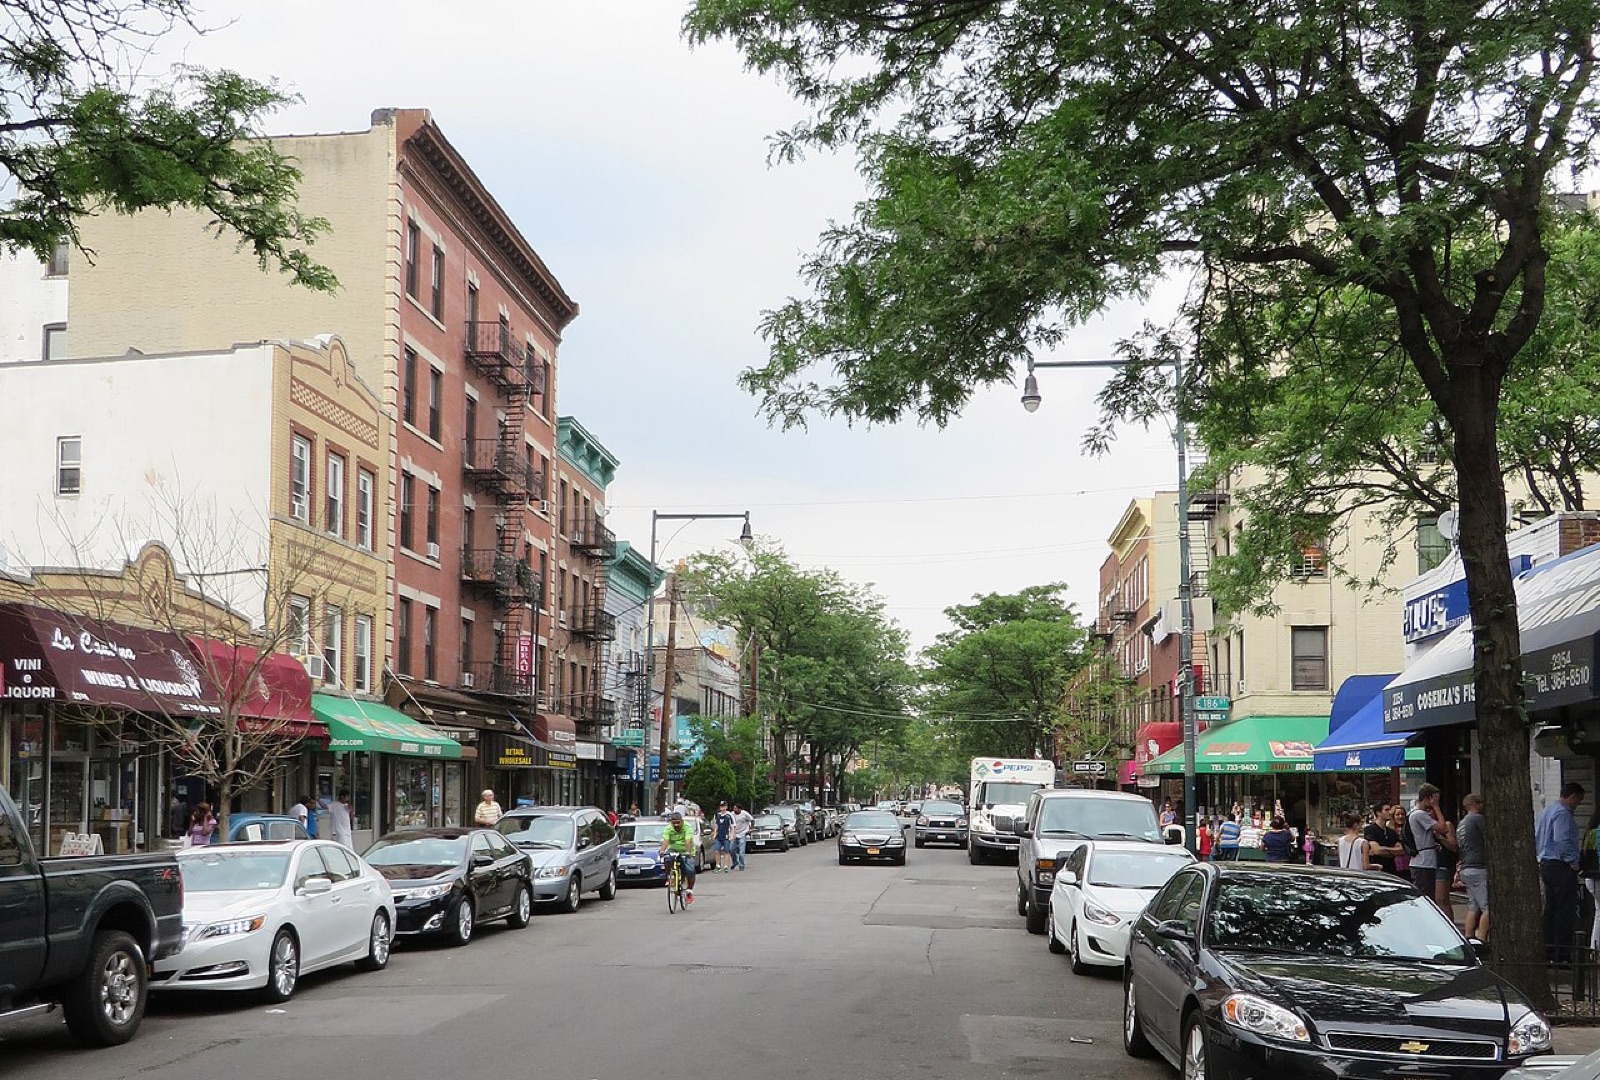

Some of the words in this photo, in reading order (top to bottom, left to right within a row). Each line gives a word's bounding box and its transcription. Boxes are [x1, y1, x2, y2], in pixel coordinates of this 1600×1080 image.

[1404, 593, 1448, 637] BLUE
[52, 627, 75, 651] La
[14, 659, 41, 670] VINI
[81, 669, 126, 688] WINES
[2, 686, 55, 698] IQUORI
[1417, 685, 1460, 711] COSENZA'S
[1204, 699, 1218, 707] 186
[506, 748, 524, 756] RETAIL
[499, 757, 531, 765] WHOLESALE
